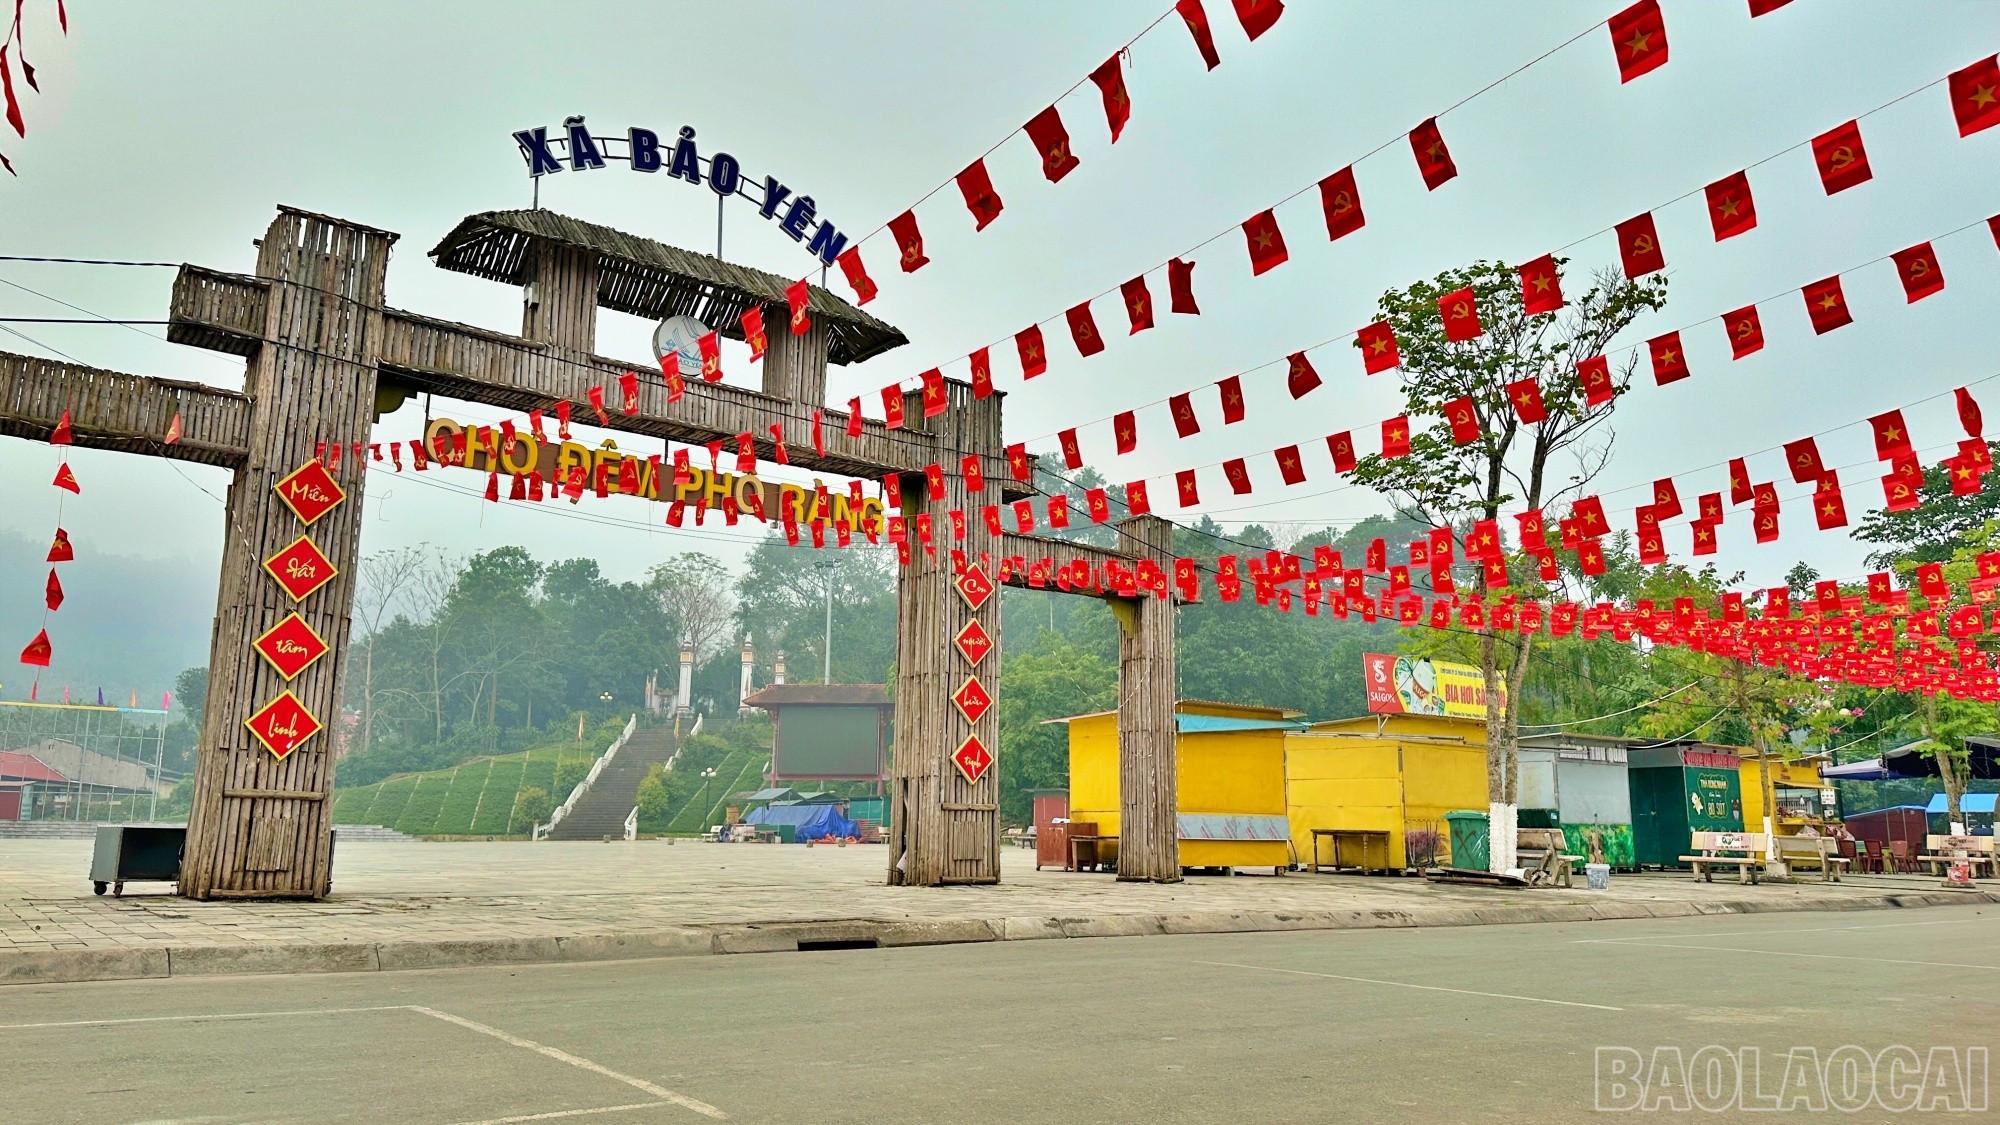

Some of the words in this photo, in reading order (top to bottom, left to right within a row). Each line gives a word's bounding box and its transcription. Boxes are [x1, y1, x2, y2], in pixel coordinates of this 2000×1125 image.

[512, 115, 607, 178] XÃ
[627, 125, 741, 196] BẢO
[759, 175, 849, 267] YÊN
[290, 479, 331, 502] Miền
[964, 578, 987, 593] Con
[276, 640, 308, 660] tâm
[1445, 683, 1459, 703] BIA
[268, 712, 298, 738] linh
